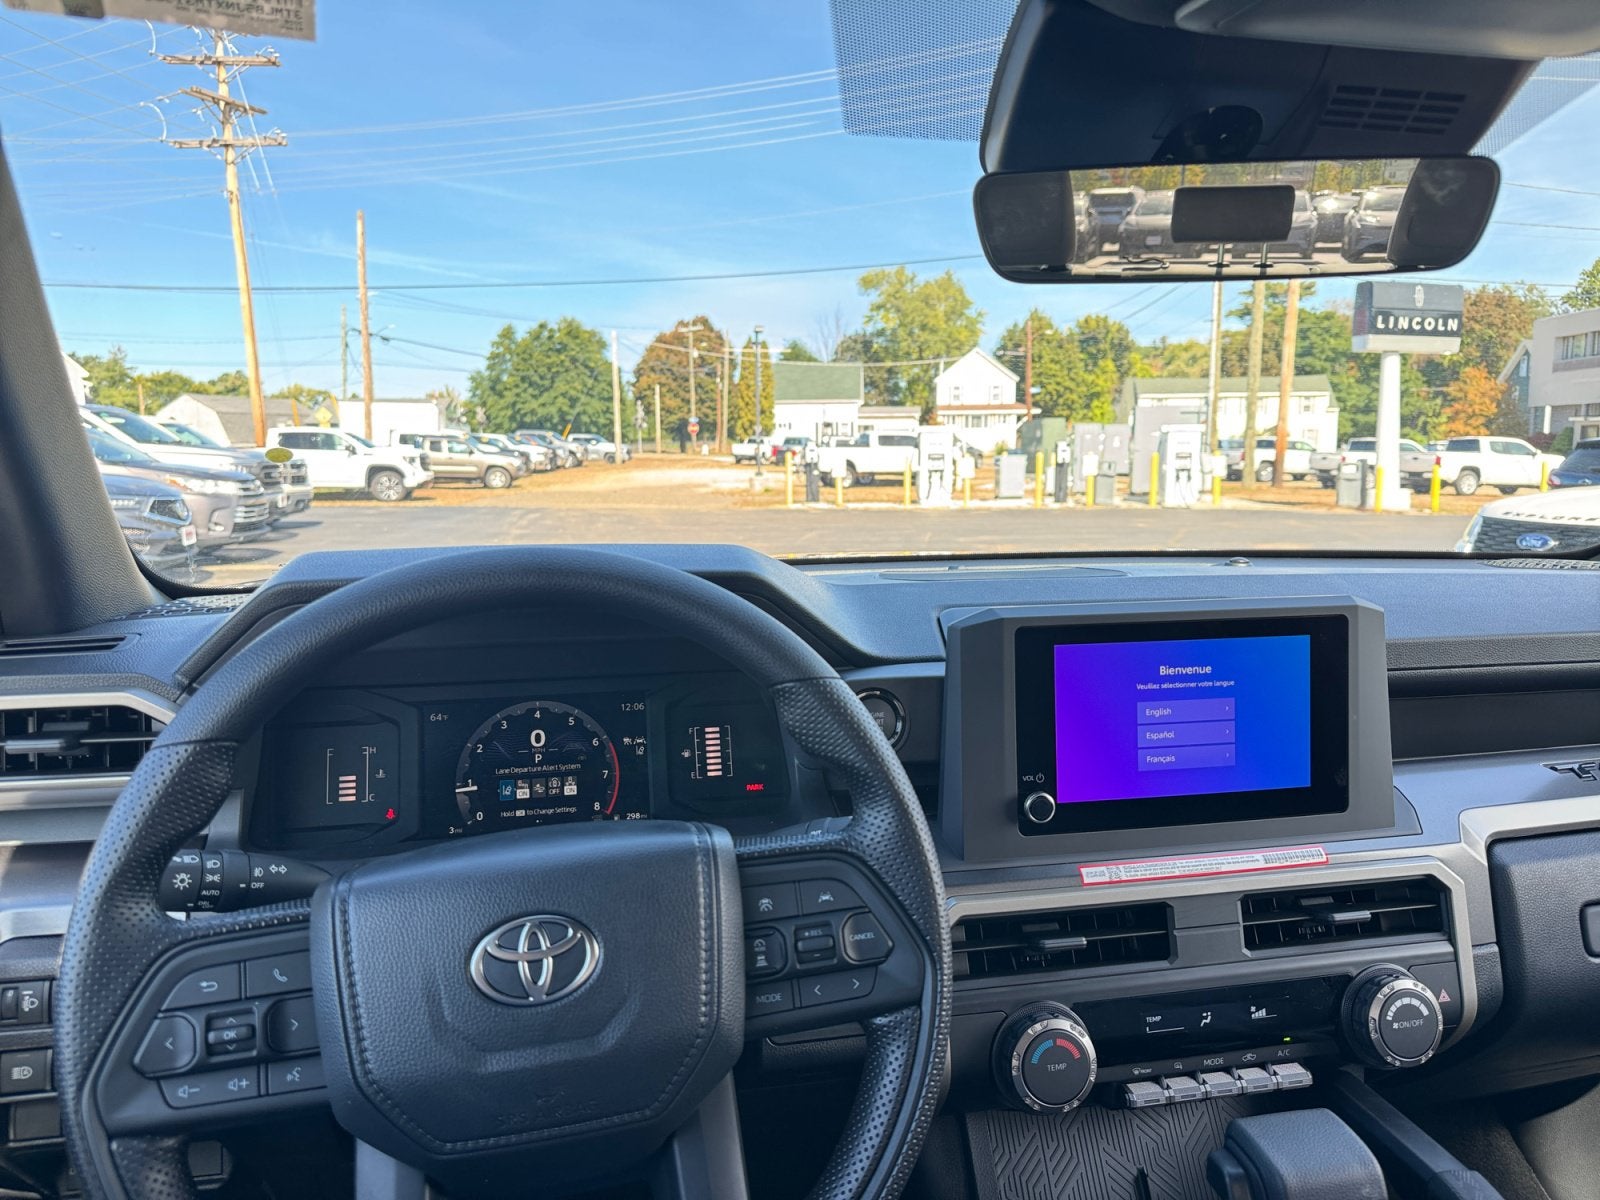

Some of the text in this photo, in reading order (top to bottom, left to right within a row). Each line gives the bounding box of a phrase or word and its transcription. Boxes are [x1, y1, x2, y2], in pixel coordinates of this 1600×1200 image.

[1376, 314, 1458, 332] LINCOLN
[1159, 665, 1212, 676] Bienvenue
[1160, 681, 1196, 689] sélectionner
[621, 702, 644, 711] 12:06
[534, 710, 540, 719] 4
[1146, 708, 1172, 718] English
[500, 720, 508, 730] 3
[568, 716, 575, 726] 5
[530, 729, 546, 748] 0
[1146, 731, 1174, 740] Español
[592, 738, 600, 746] 6
[476, 744, 484, 753] 2
[535, 754, 542, 764] P
[1146, 755, 1176, 764] Français
[510, 766, 542, 775] Departure
[559, 763, 581, 771] System
[602, 770, 608, 779] 7
[369, 794, 376, 802] C
[594, 802, 600, 811] 8
[476, 812, 484, 821] 0
[534, 808, 554, 816] Change
[850, 932, 875, 941] CANCEL
[756, 993, 783, 1004] MODE
[1146, 1016, 1162, 1024] TEMP
[1398, 1018, 1424, 1029] ON/OFF
[223, 1030, 237, 1040] OK
[1277, 1048, 1290, 1057] A/C
[1203, 1057, 1224, 1067] MODE
[1046, 1062, 1067, 1072] TEMP
